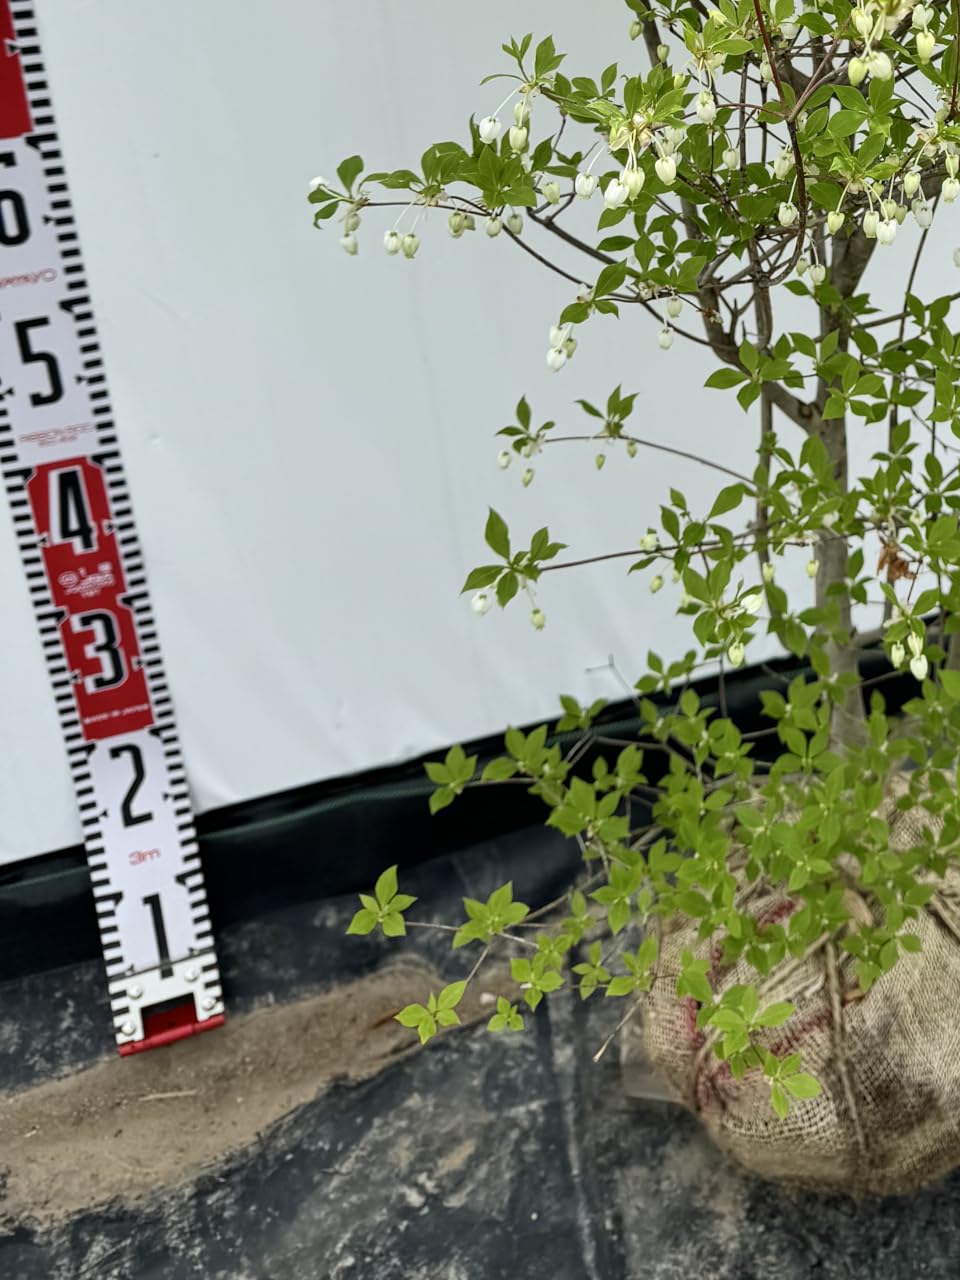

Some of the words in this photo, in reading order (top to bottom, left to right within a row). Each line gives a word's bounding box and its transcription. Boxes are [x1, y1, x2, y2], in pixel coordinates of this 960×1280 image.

[14, 316, 64, 407] 5
[52, 467, 96, 552] 4
[75, 610, 127, 692] 3
[109, 744, 154, 828] 2
[141, 893, 174, 980] 1
